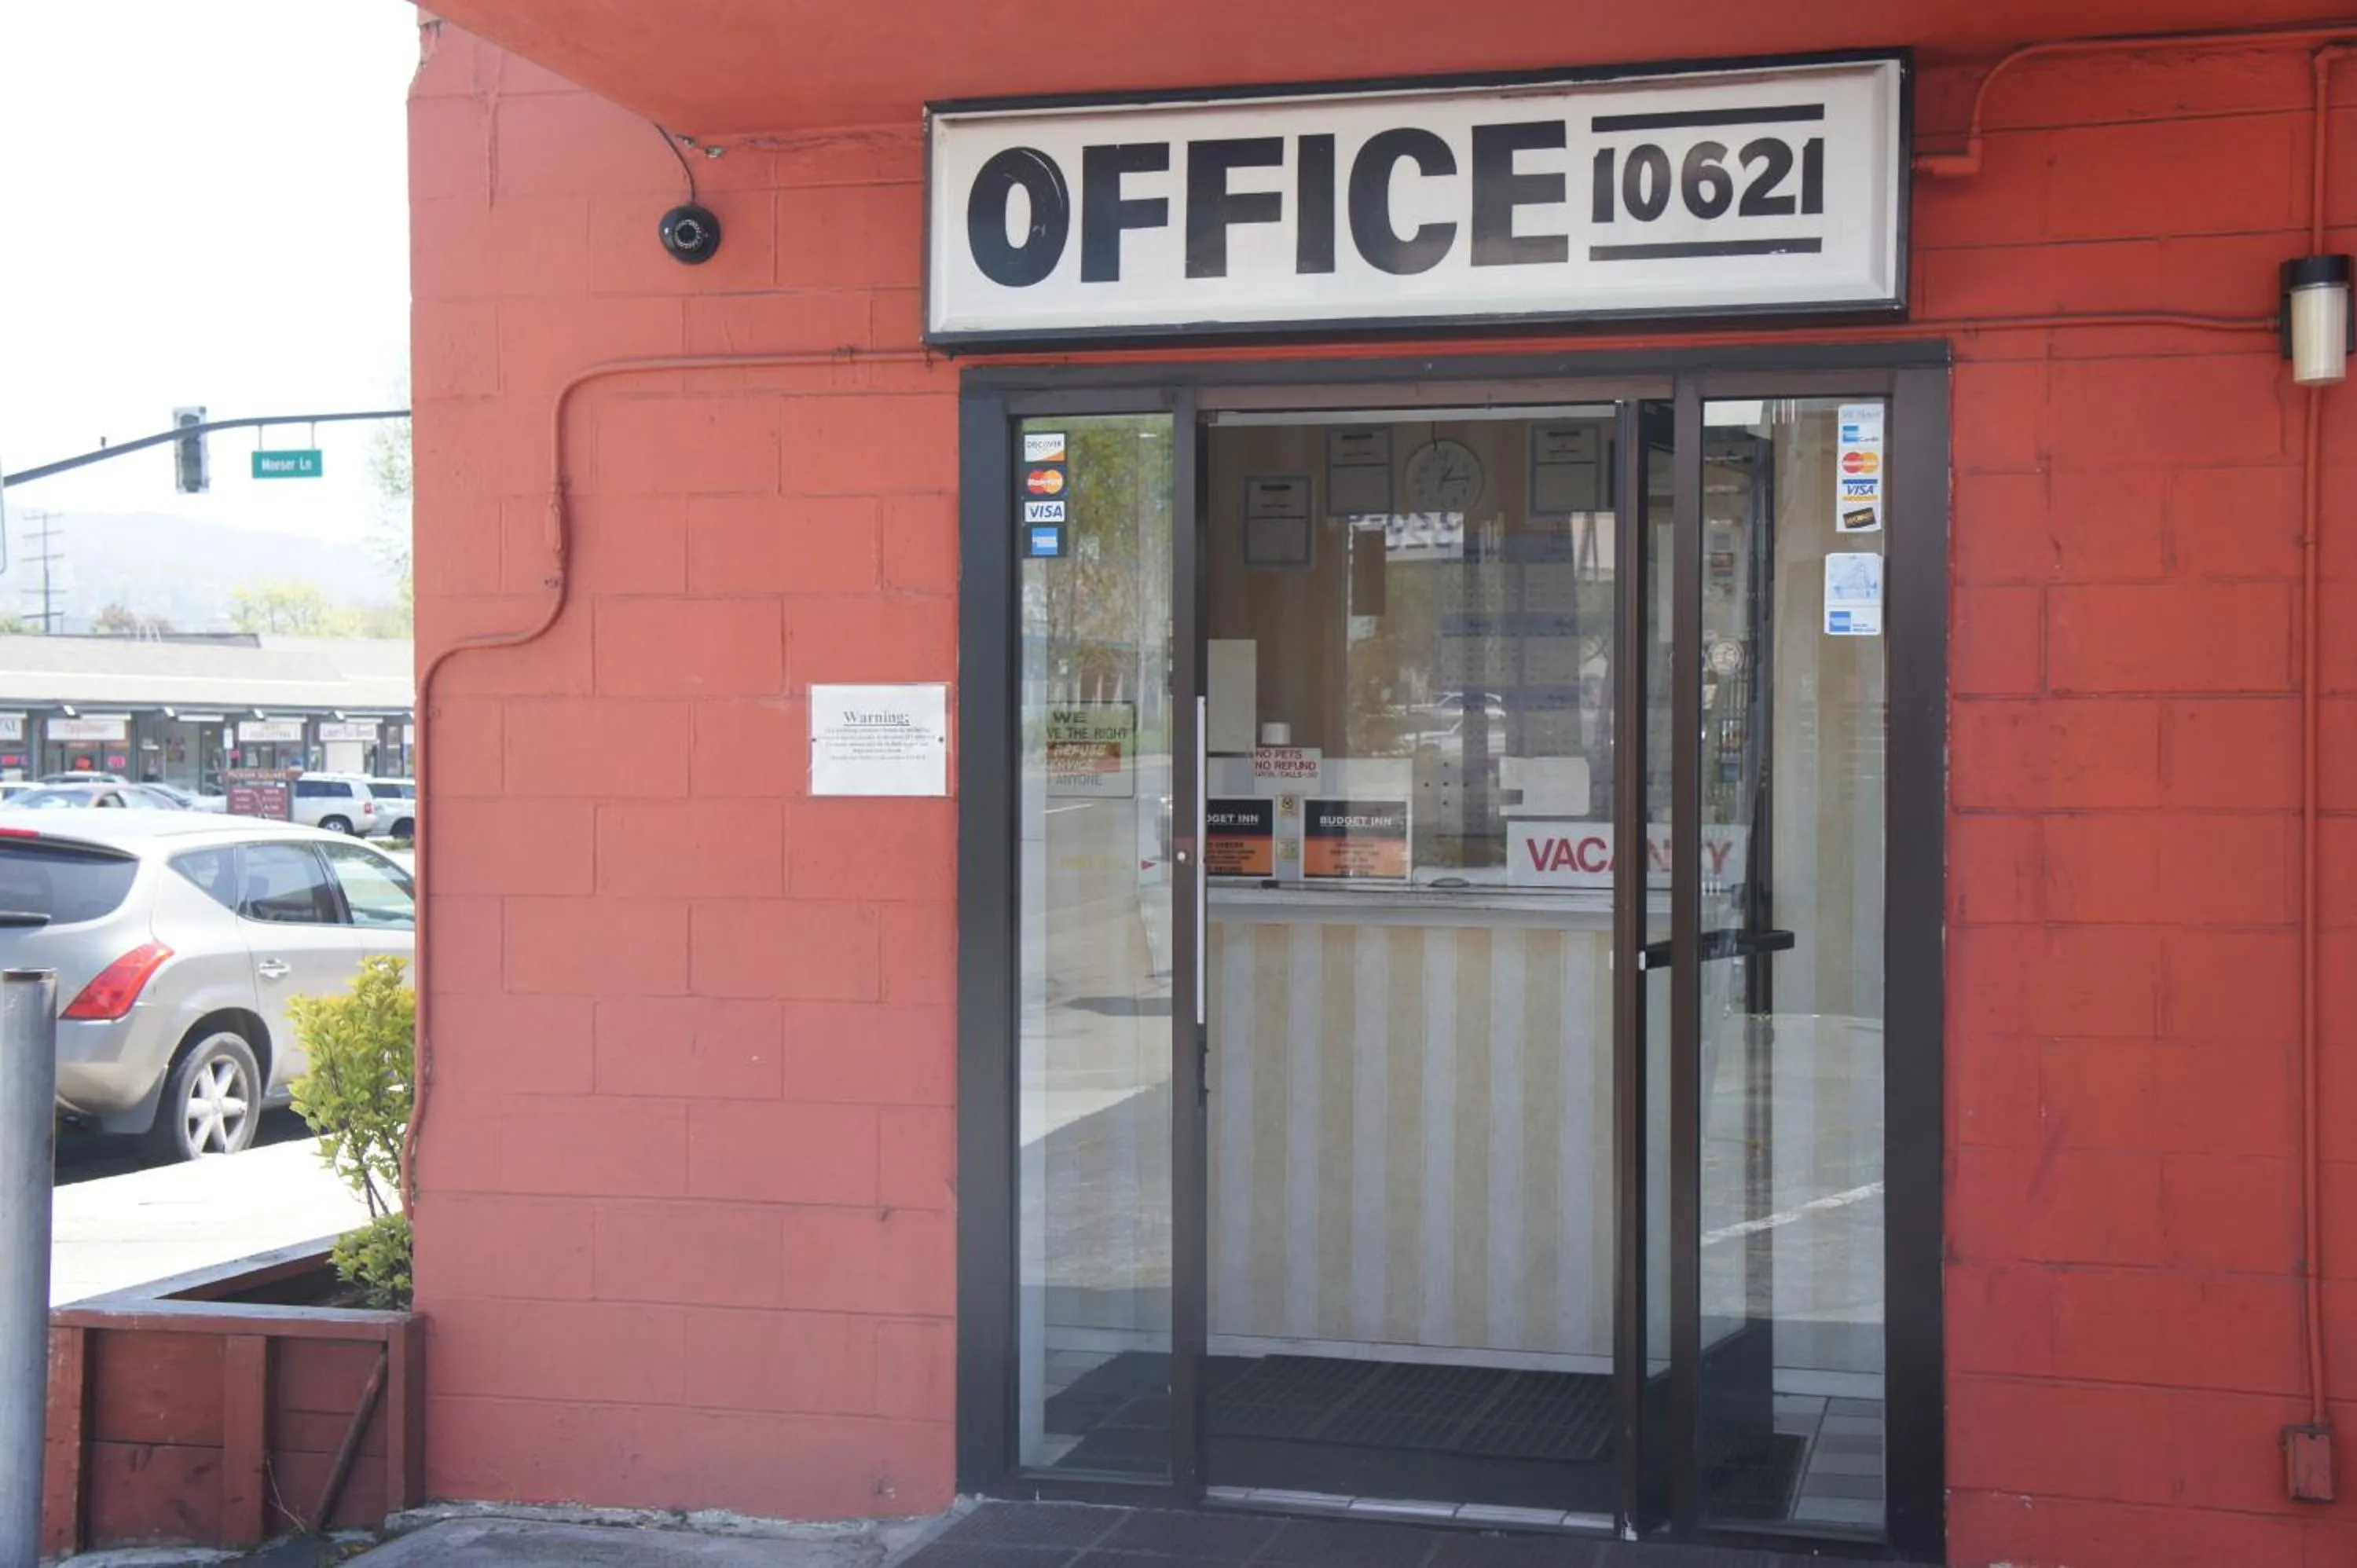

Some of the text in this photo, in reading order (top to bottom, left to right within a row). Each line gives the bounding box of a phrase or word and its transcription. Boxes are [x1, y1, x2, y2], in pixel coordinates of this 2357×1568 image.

[967, 119, 1825, 288] OFFICE 10621
[1847, 485, 1875, 496] VISA
[1029, 504, 1063, 518] VISA
[1053, 711, 1087, 724] WE
[1047, 727, 1128, 740] VE THE RIGHT
[1256, 749, 1272, 759] NO
[1255, 760, 1318, 771] NO REFUND
[1207, 814, 1259, 823] DGET INN
[1319, 815, 1392, 826] BUDGET INN
[1526, 837, 1733, 875] VACNY
